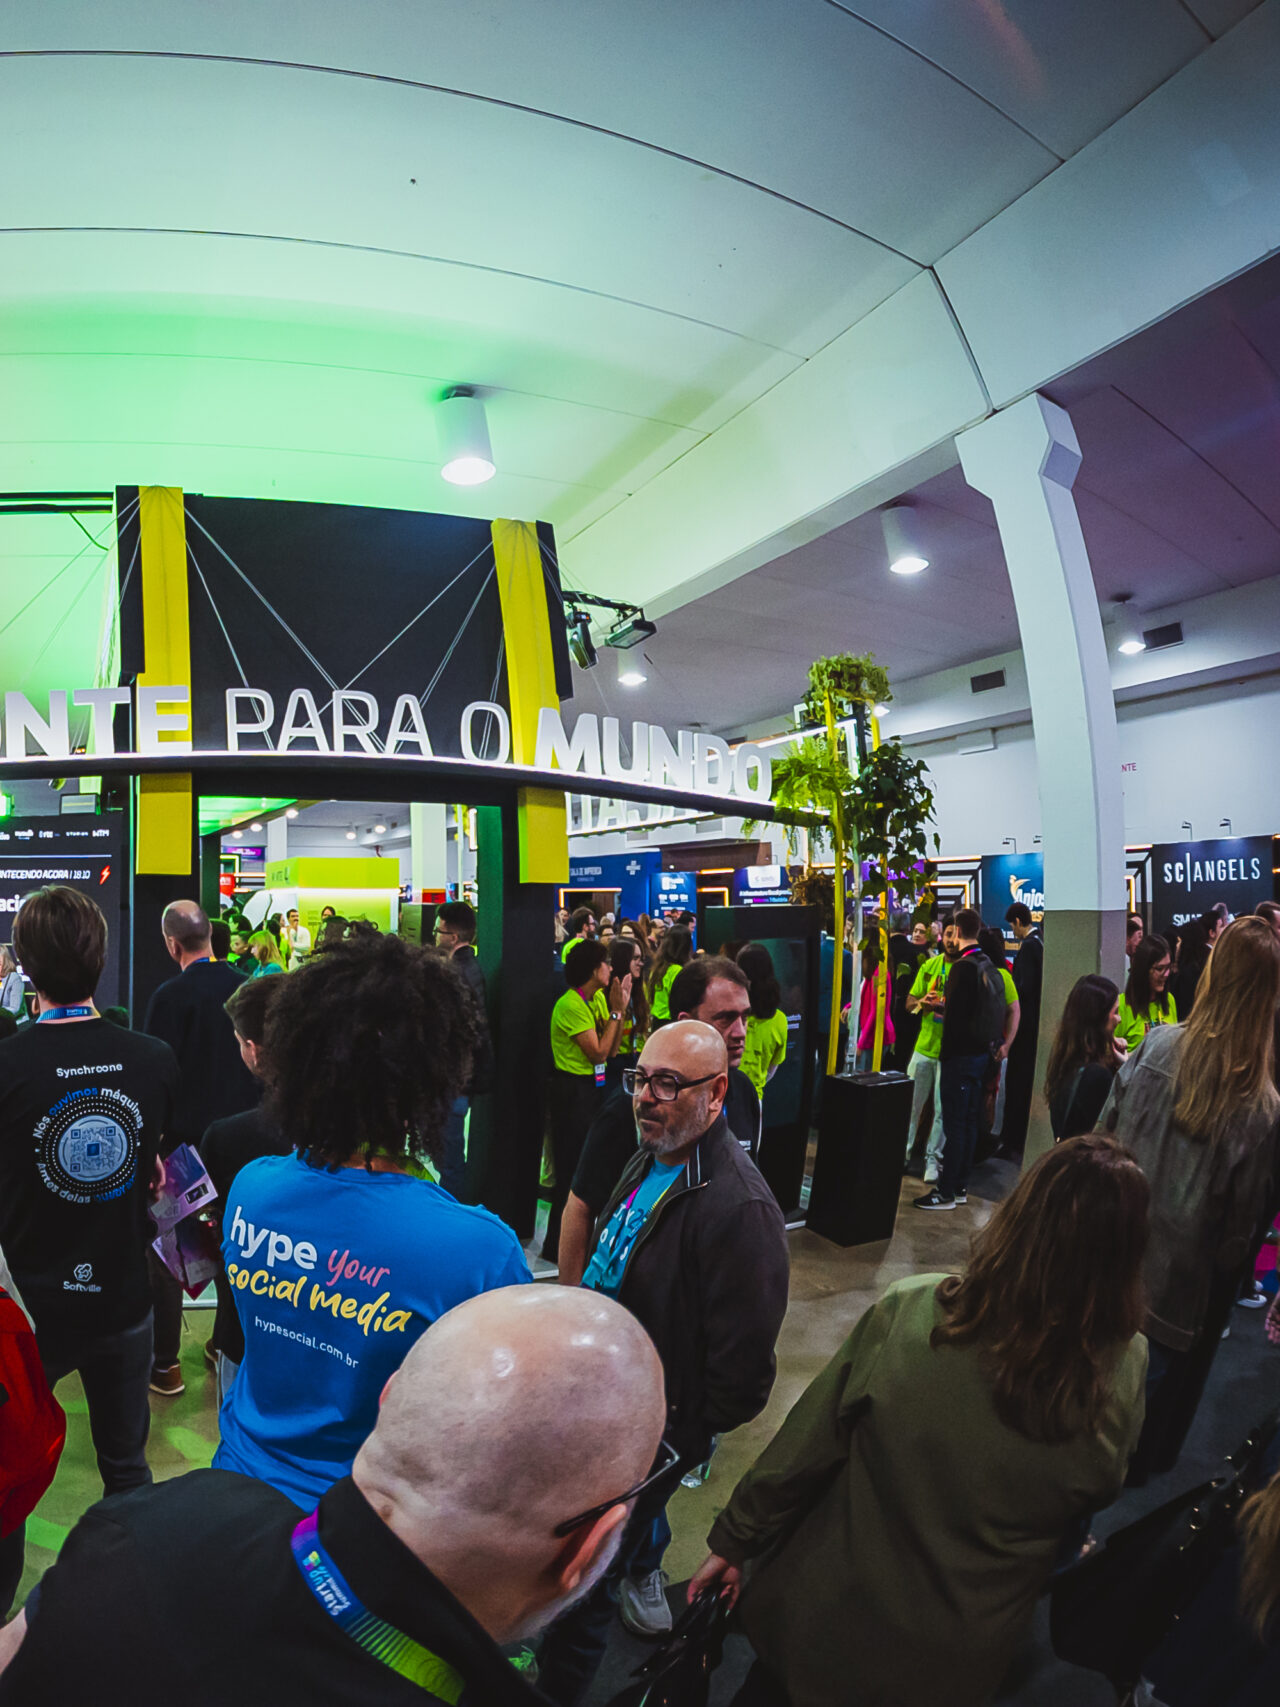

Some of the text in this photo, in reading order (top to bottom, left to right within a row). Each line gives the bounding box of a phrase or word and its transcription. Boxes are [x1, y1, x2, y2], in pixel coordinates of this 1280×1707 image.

[226, 688, 434, 757] PARA
[460, 701, 510, 764] O
[534, 707, 773, 802] MUNDO
[1121, 762, 1137, 772] NTE
[42, 869, 68, 879] AGORA
[230, 1206, 317, 1270] hype
[63, 1280, 102, 1293] Softville
[310, 1283, 413, 1336] media
[254, 1315, 359, 1369] hypesocial.com.br
